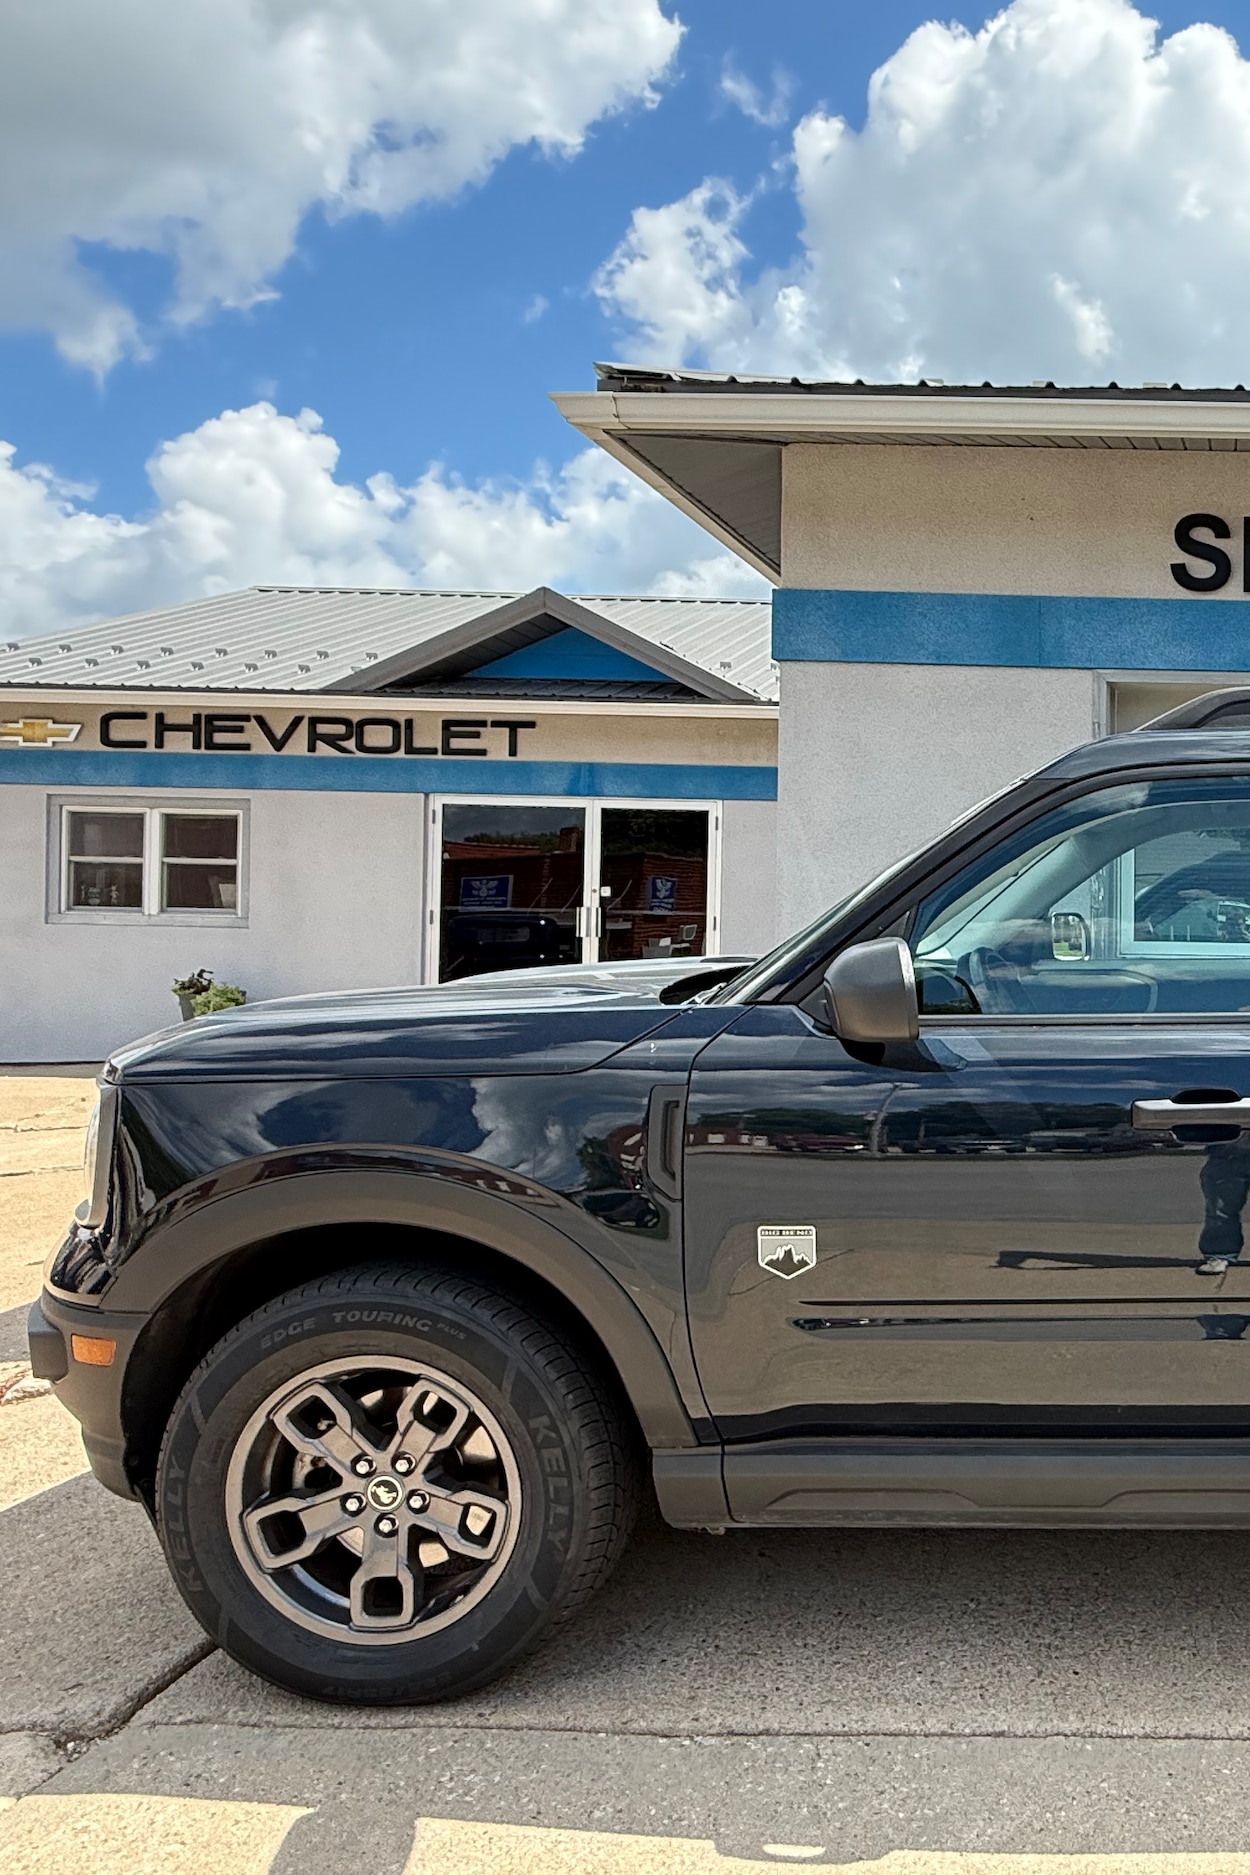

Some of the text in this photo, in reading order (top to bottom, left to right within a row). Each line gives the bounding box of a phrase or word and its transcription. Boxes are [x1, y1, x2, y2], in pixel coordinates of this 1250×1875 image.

[100, 711, 537, 758] CHEVROLET
[260, 1310, 467, 1350] EDGE TOURING PLUS
[166, 1454, 204, 1592] KELLY
[527, 1413, 571, 1552] KELLY
